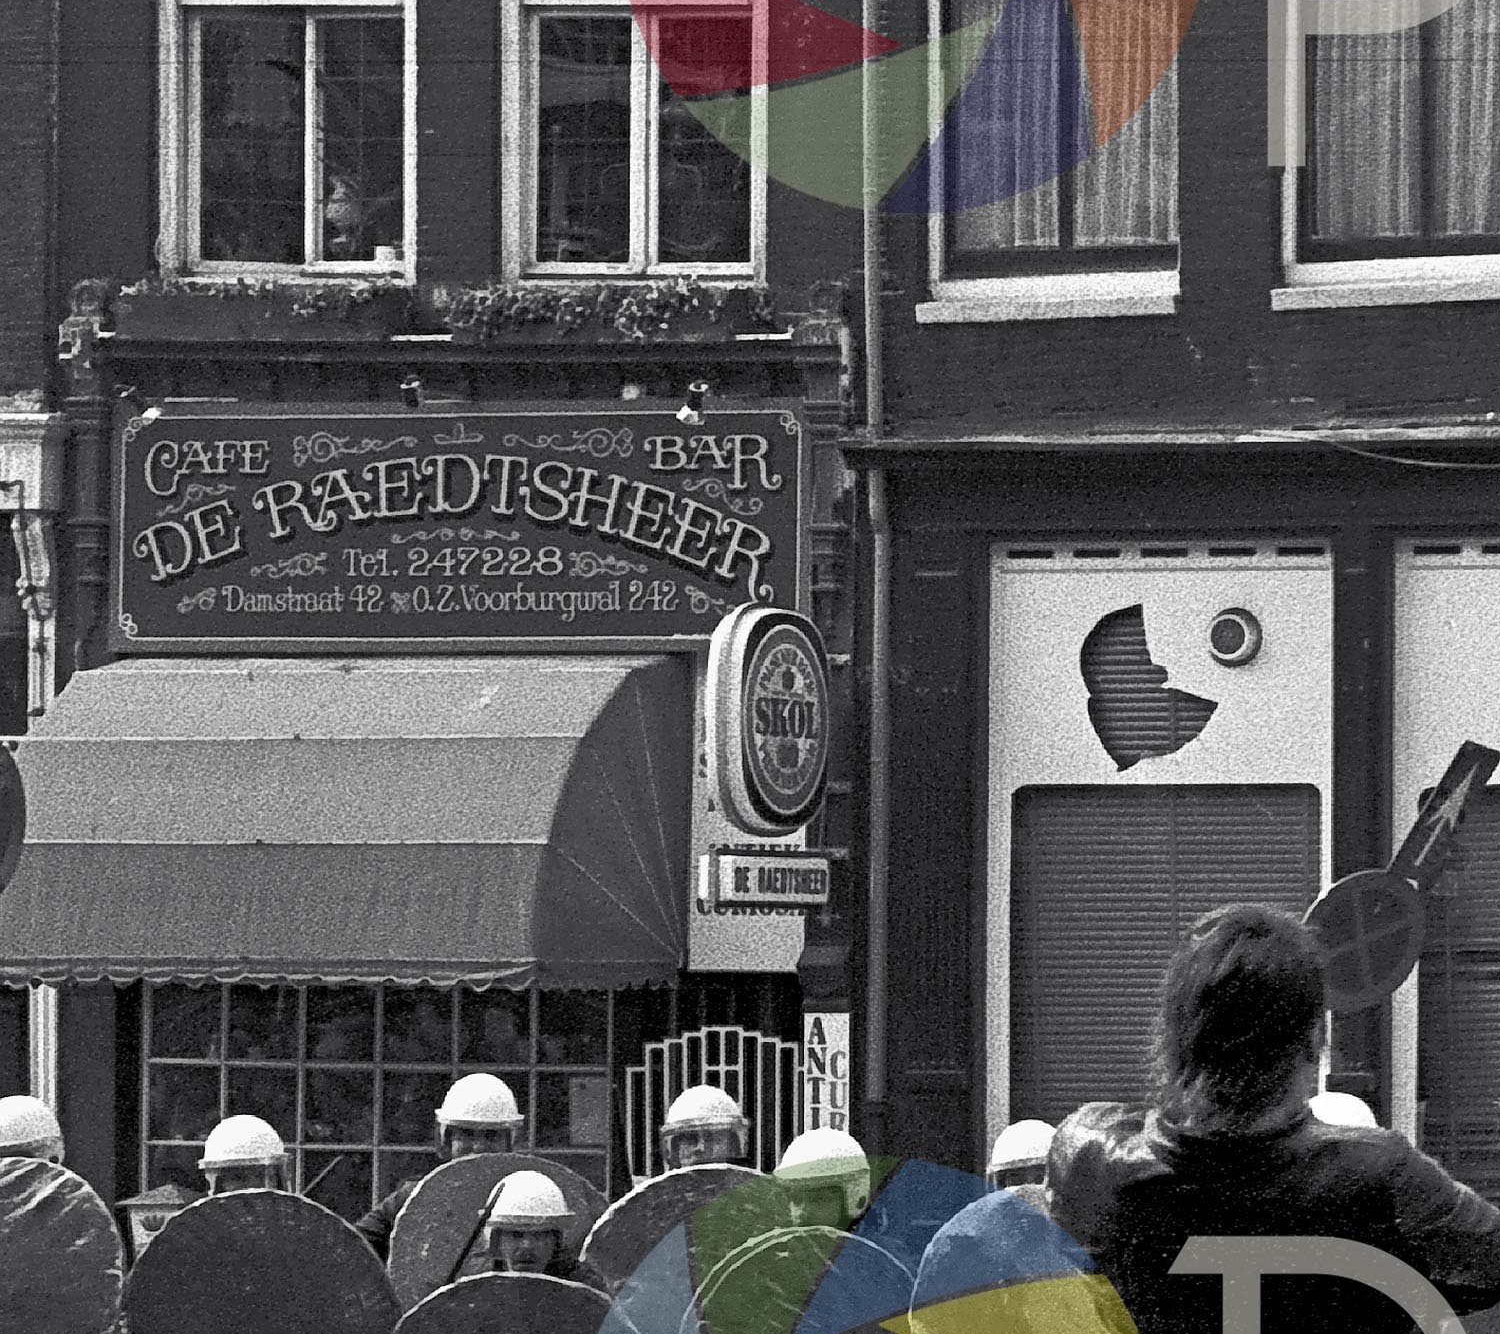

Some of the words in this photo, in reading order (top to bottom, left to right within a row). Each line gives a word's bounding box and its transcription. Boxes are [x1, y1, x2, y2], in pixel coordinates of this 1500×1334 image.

[144, 439, 272, 497] CAFE
[643, 433, 784, 491] BAR
[132, 499, 243, 582] DE
[252, 451, 776, 604] RAEDTSHEER
[407, 545, 564, 578] 247228
[220, 583, 346, 614] Damstraat
[350, 584, 385, 614] 42
[627, 579, 681, 613] 242
[754, 696, 819, 740] SKOL
